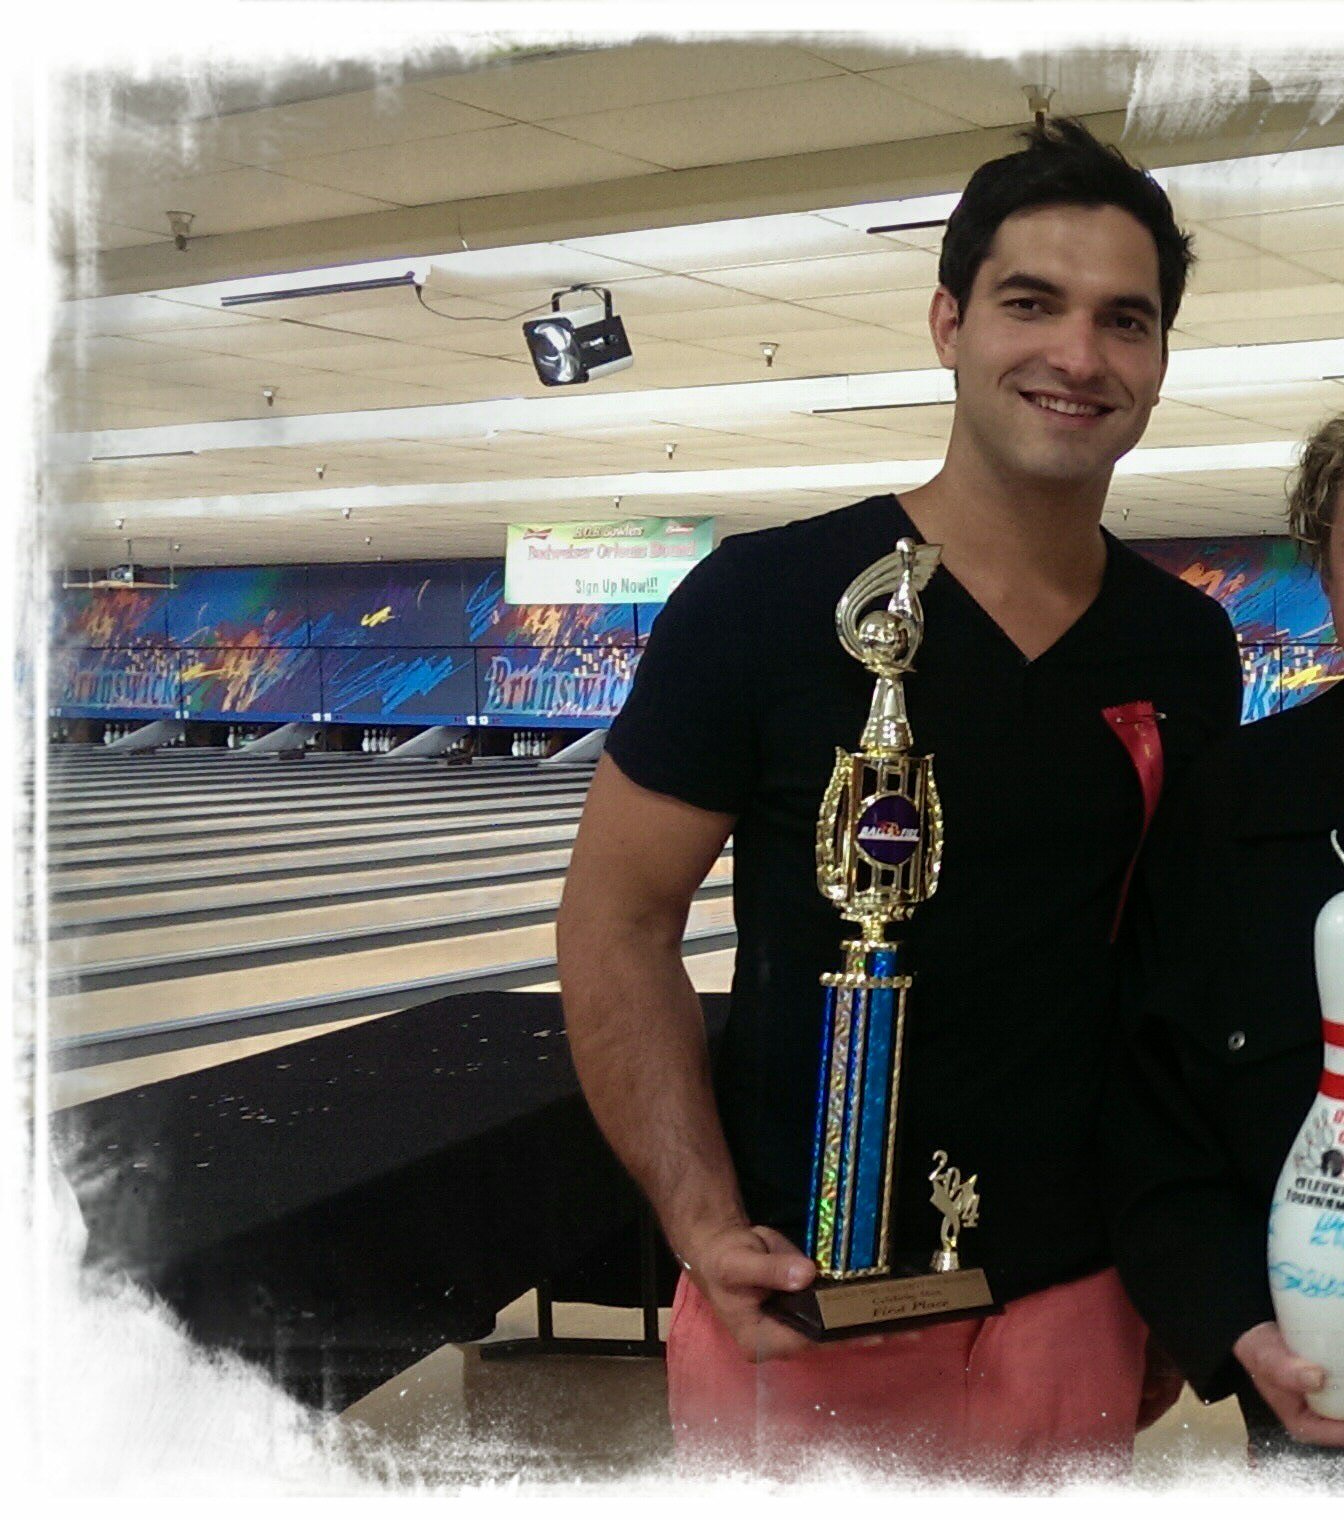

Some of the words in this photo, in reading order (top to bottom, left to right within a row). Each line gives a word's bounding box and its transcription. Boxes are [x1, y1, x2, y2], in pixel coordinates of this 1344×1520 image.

[527, 545, 593, 561] Budweiser
[575, 578, 599, 595] Sign
[602, 578, 617, 597] Up
[873, 1305, 906, 1318] First
[912, 1299, 950, 1312] Place
